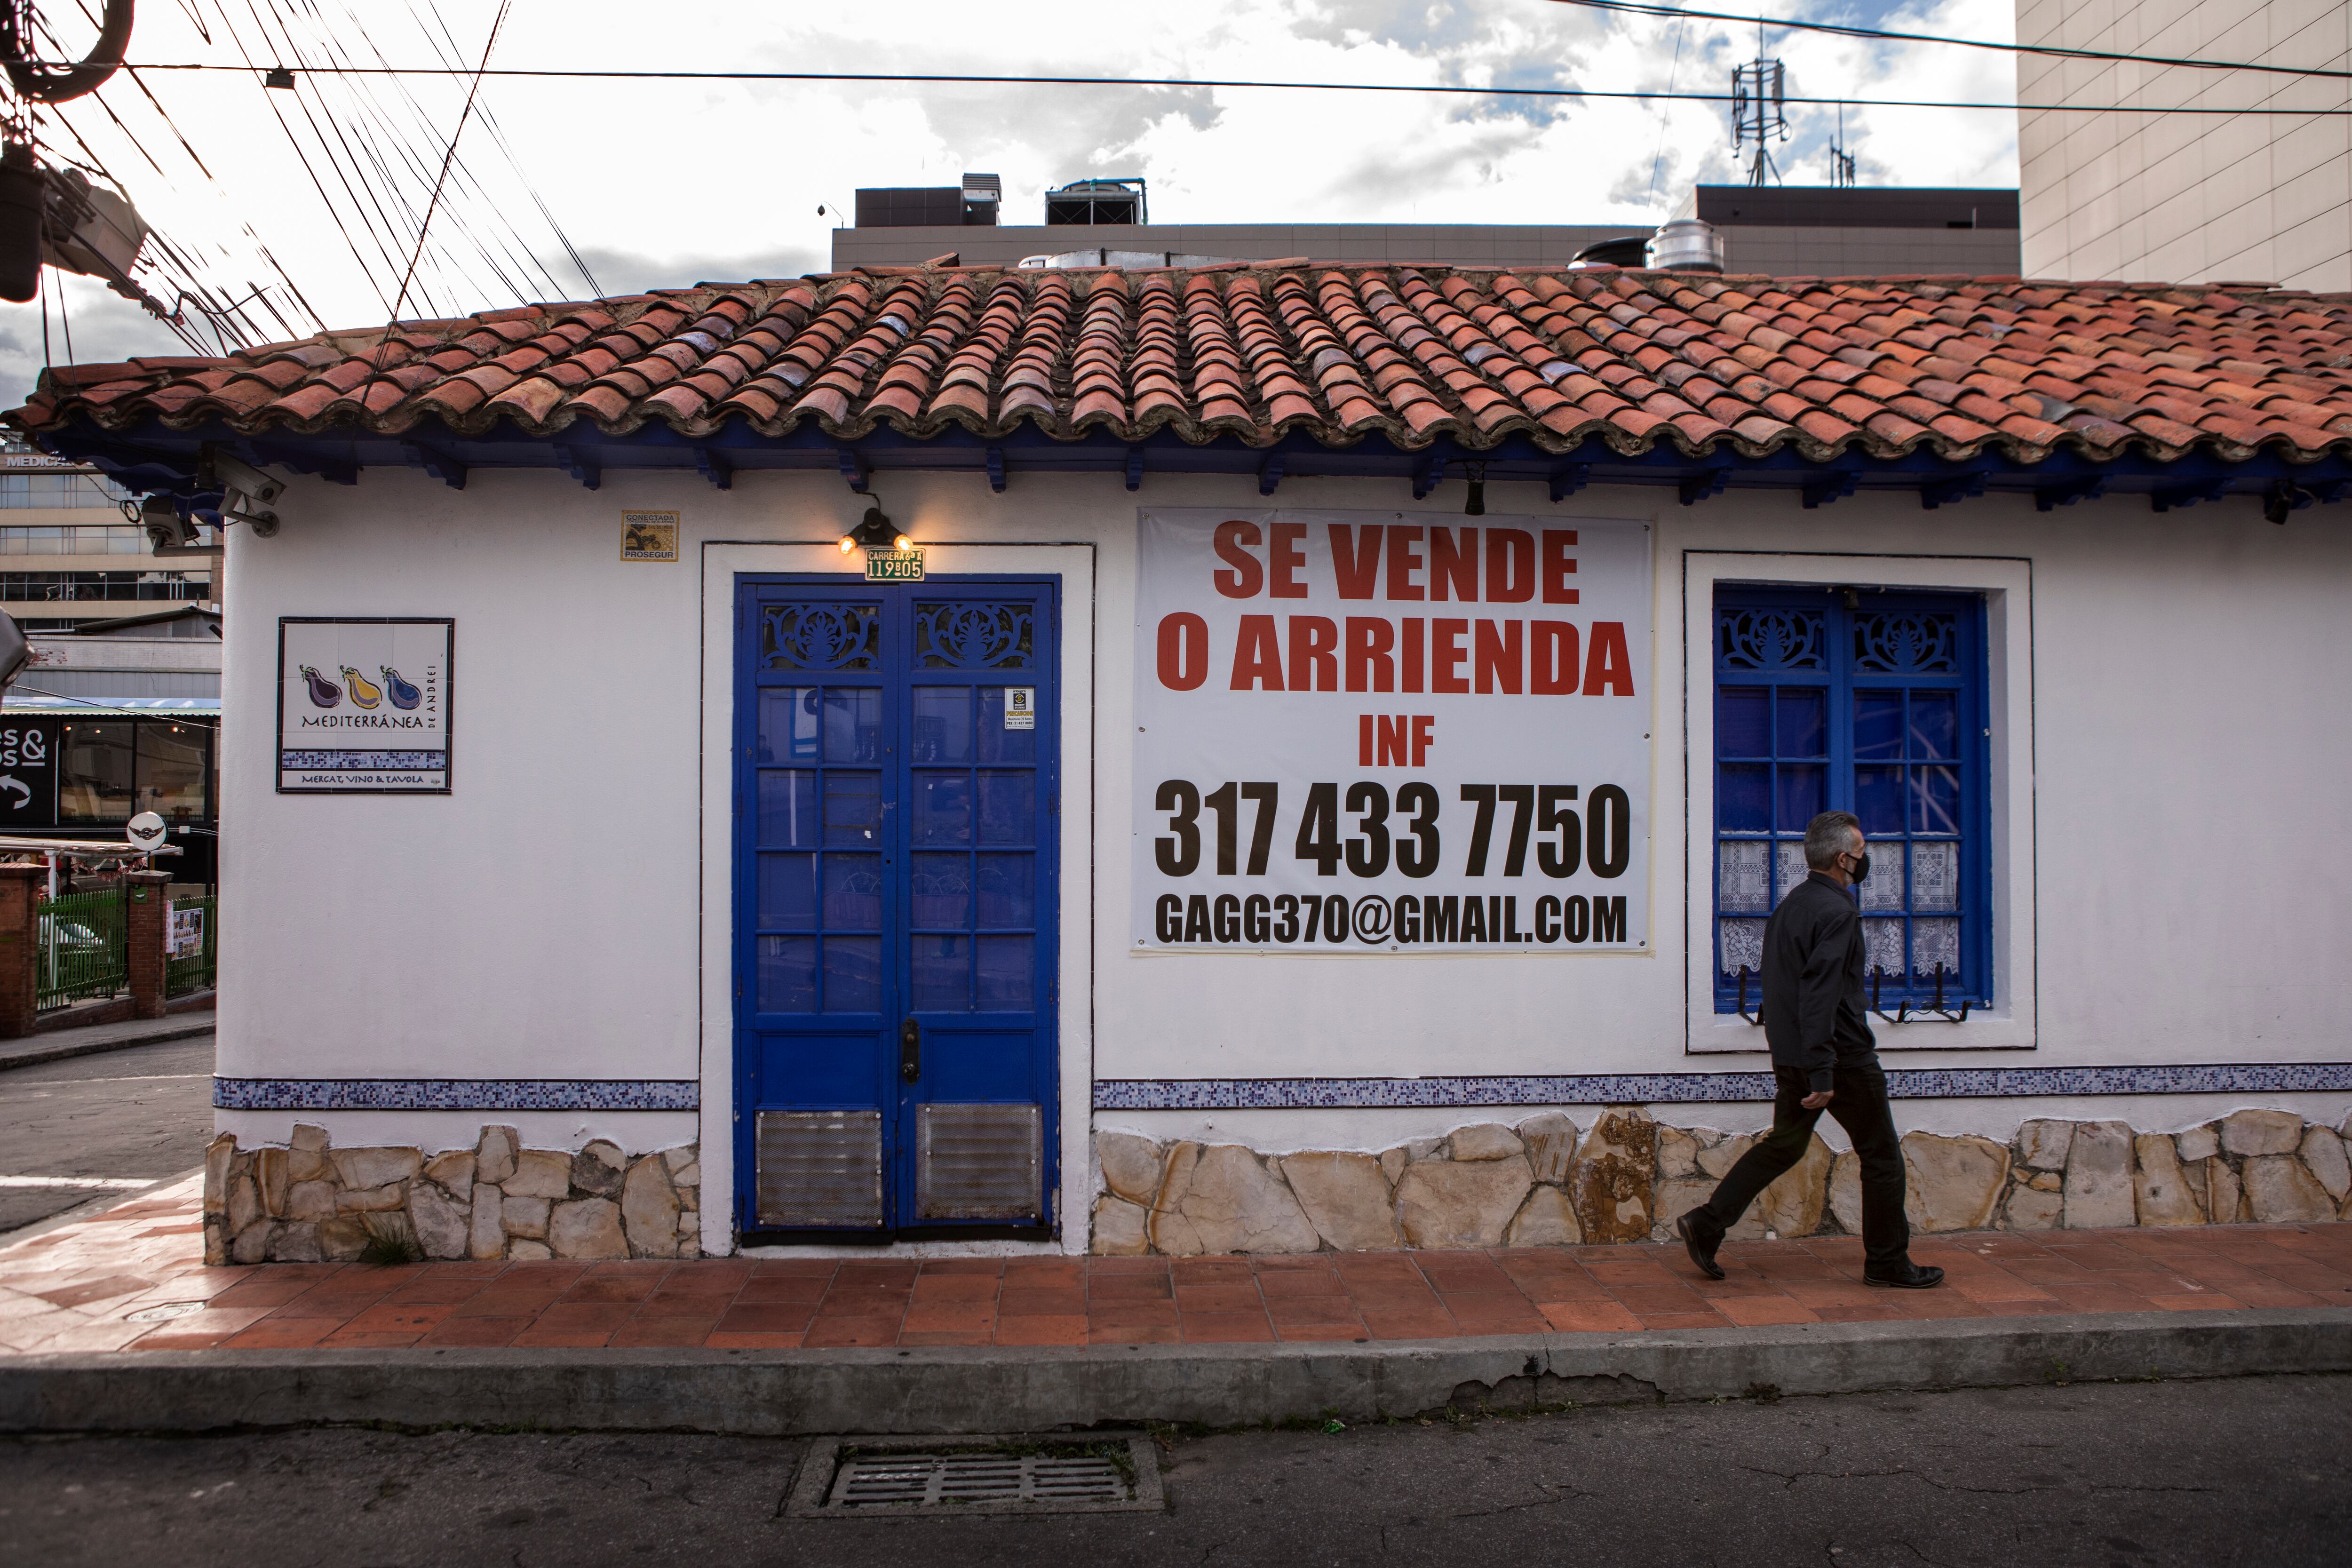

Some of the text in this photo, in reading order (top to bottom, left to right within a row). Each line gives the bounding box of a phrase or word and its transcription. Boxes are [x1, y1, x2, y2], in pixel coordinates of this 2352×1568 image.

[869, 552, 904, 560] CARRERA
[1213, 520, 1580, 605] SE VENDE
[1157, 612, 1635, 697] O ARRIENDA
[302, 714, 423, 728] MEDITERRÁNEA
[427, 666, 437, 729] DE ANDREI
[1359, 715, 1435, 767] INF
[302, 775, 344, 784] MERCAT,
[1155, 780, 1630, 879] 317 433 7750
[1156, 893, 1627, 945] GAGG370@GMAIL.COM
